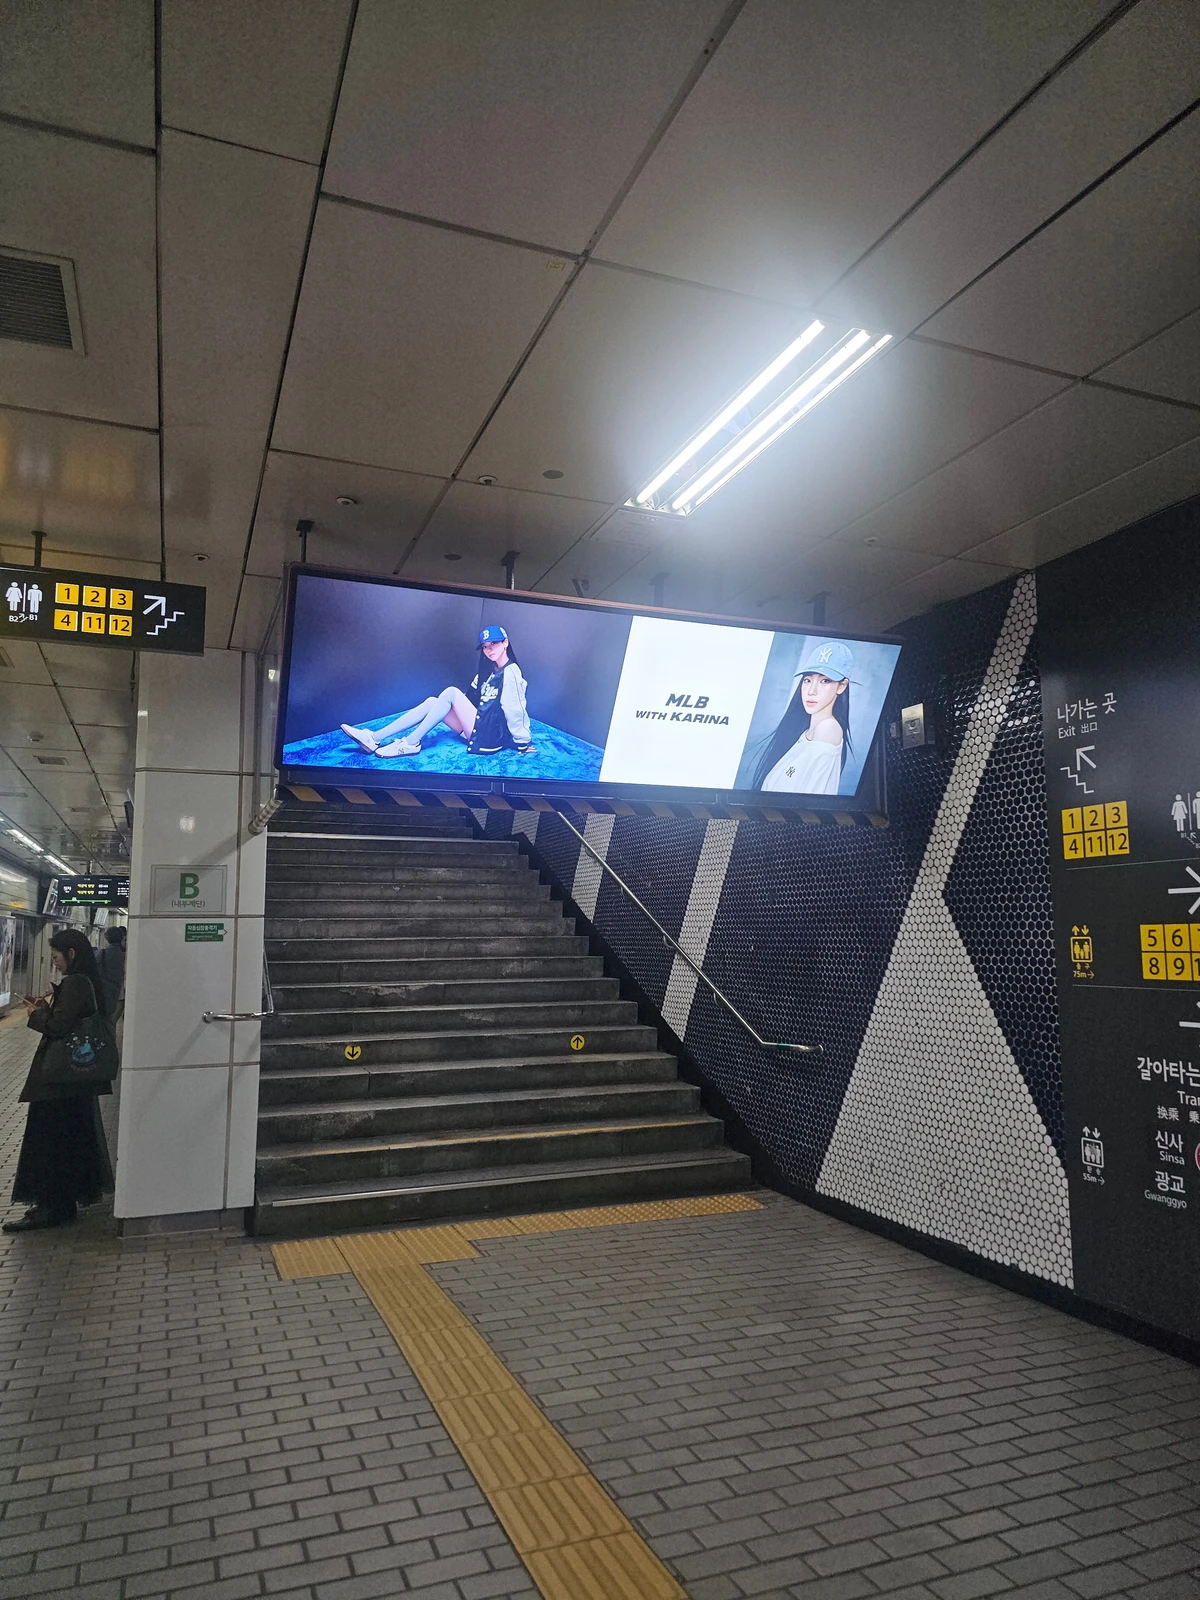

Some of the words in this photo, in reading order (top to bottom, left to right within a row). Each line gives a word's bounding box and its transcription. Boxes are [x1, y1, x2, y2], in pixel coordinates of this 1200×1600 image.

[64, 587, 70, 600] 1
[90, 590, 100, 603] 2
[117, 593, 127, 606] 3
[60, 614, 71, 627] 4
[86, 616, 102, 630] 11
[112, 619, 130, 632] 12
[665, 693, 710, 709] MLB
[1057, 698, 1098, 723] 나가는
[1102, 692, 1117, 714] 곳
[635, 710, 668, 721] WITH
[670, 711, 730, 726] KARINA
[1058, 725, 1076, 739] Exit
[1080, 722, 1098, 734] 出口
[1068, 813, 1075, 829] 1
[1089, 809, 1099, 827] 2
[1112, 806, 1121, 824] 3
[1069, 838, 1079, 855] 4
[1087, 836, 1103, 853] 11
[1108, 833, 1128, 851] 12
[180, 873, 200, 899] B
[171, 900, 206, 908] (내부계단)
[1147, 929, 1158, 947] 5
[1171, 928, 1183, 947] 6
[1149, 957, 1160, 975] 8
[1173, 957, 1185, 976] 9
[1137, 1056, 1200, 1087] 갈아타는
[1155, 1130, 1184, 1153] 신사
[1159, 1150, 1185, 1165] Sinsa
[1155, 1170, 1186, 1194] 광교
[1144, 1189, 1188, 1209] Gwanggyo
